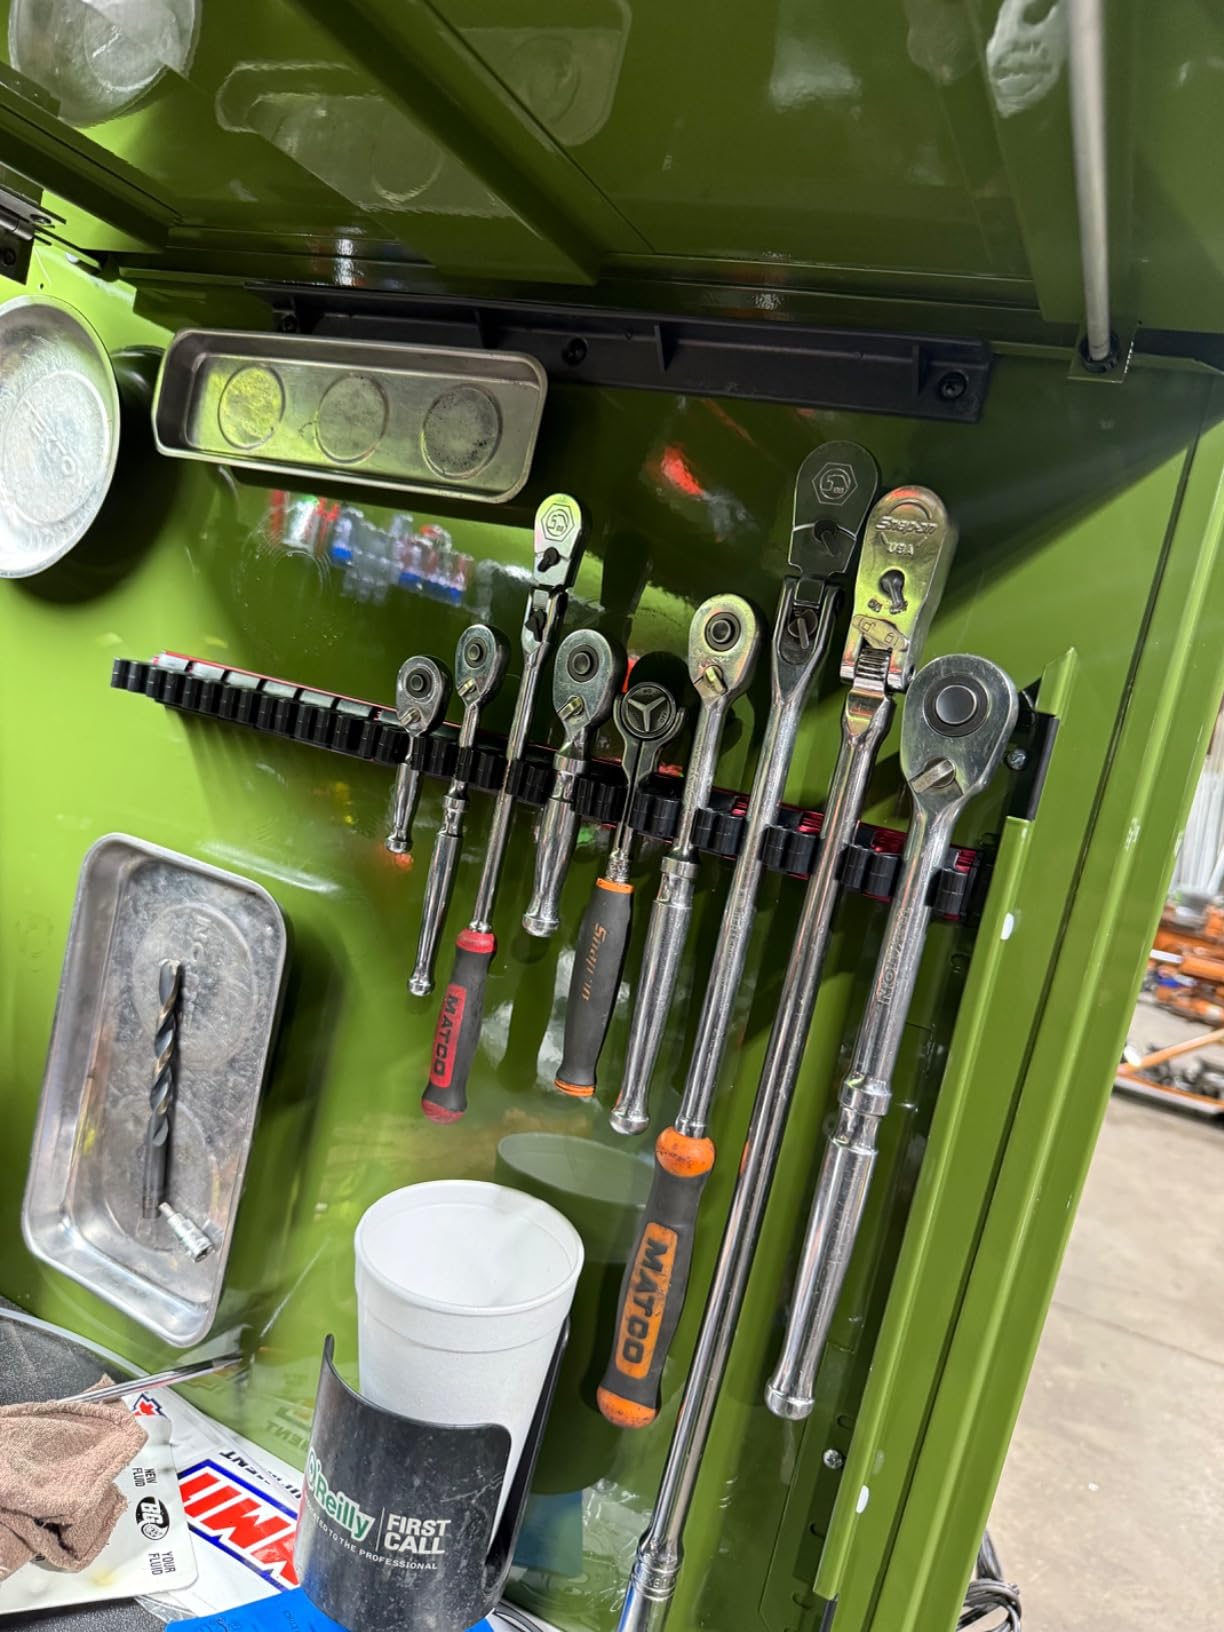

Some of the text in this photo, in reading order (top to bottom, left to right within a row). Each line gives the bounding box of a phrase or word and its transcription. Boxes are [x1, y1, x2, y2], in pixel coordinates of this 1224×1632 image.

[432, 995, 459, 1077] MATCO
[622, 1237, 669, 1364] MATCO
[132, 1467, 146, 1487] FLUID
[144, 1467, 157, 1484] NEW
[387, 1513, 452, 1537] FIRST
[340, 1537, 357, 1552] THE
[358, 1549, 438, 1570] PROFESSIONAL
[383, 1531, 446, 1555] CALL
[148, 1553, 163, 1576] FLUID
[161, 1551, 176, 1574] YOUR
